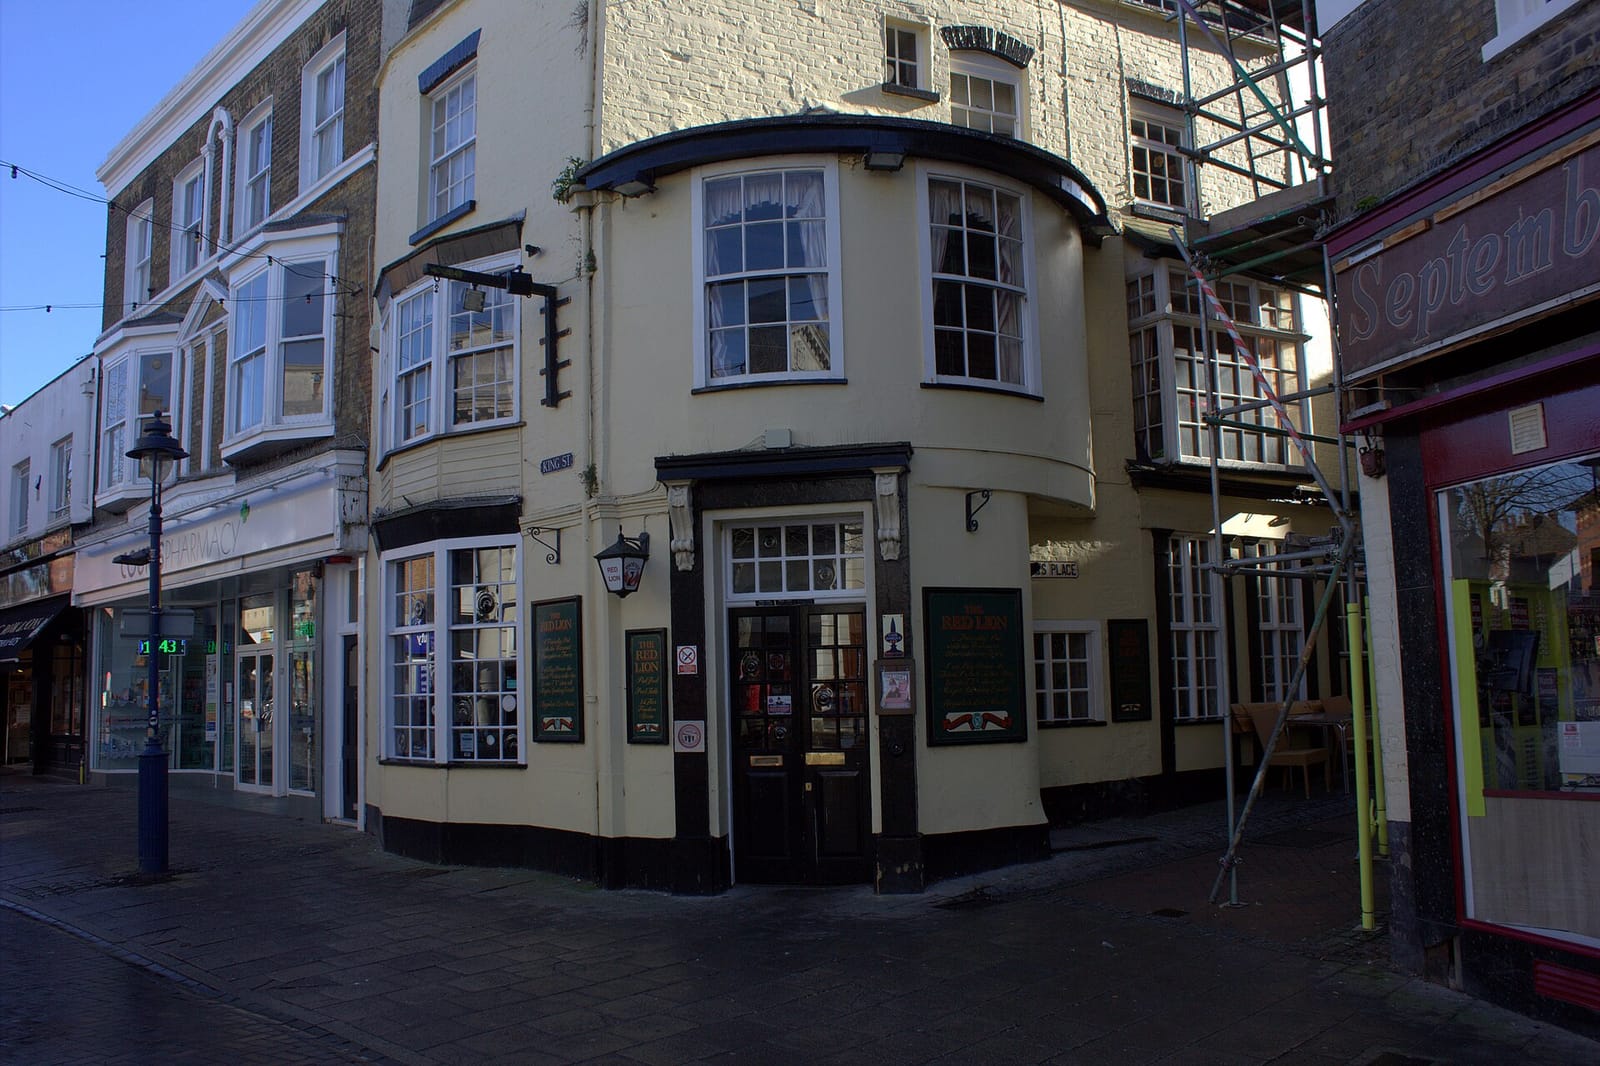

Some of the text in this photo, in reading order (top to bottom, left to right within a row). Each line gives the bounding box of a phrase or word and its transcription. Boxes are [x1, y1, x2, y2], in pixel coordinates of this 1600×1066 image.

[1350, 153, 1600, 346] Septemb
[543, 456, 560, 473] KING
[606, 566, 618, 574] RED
[1051, 563, 1077, 576] PLACE
[540, 616, 572, 633] RED LION
[941, 615, 1008, 632] RED LION
[635, 649, 658, 662] RED
[634, 662, 659, 673] LION
